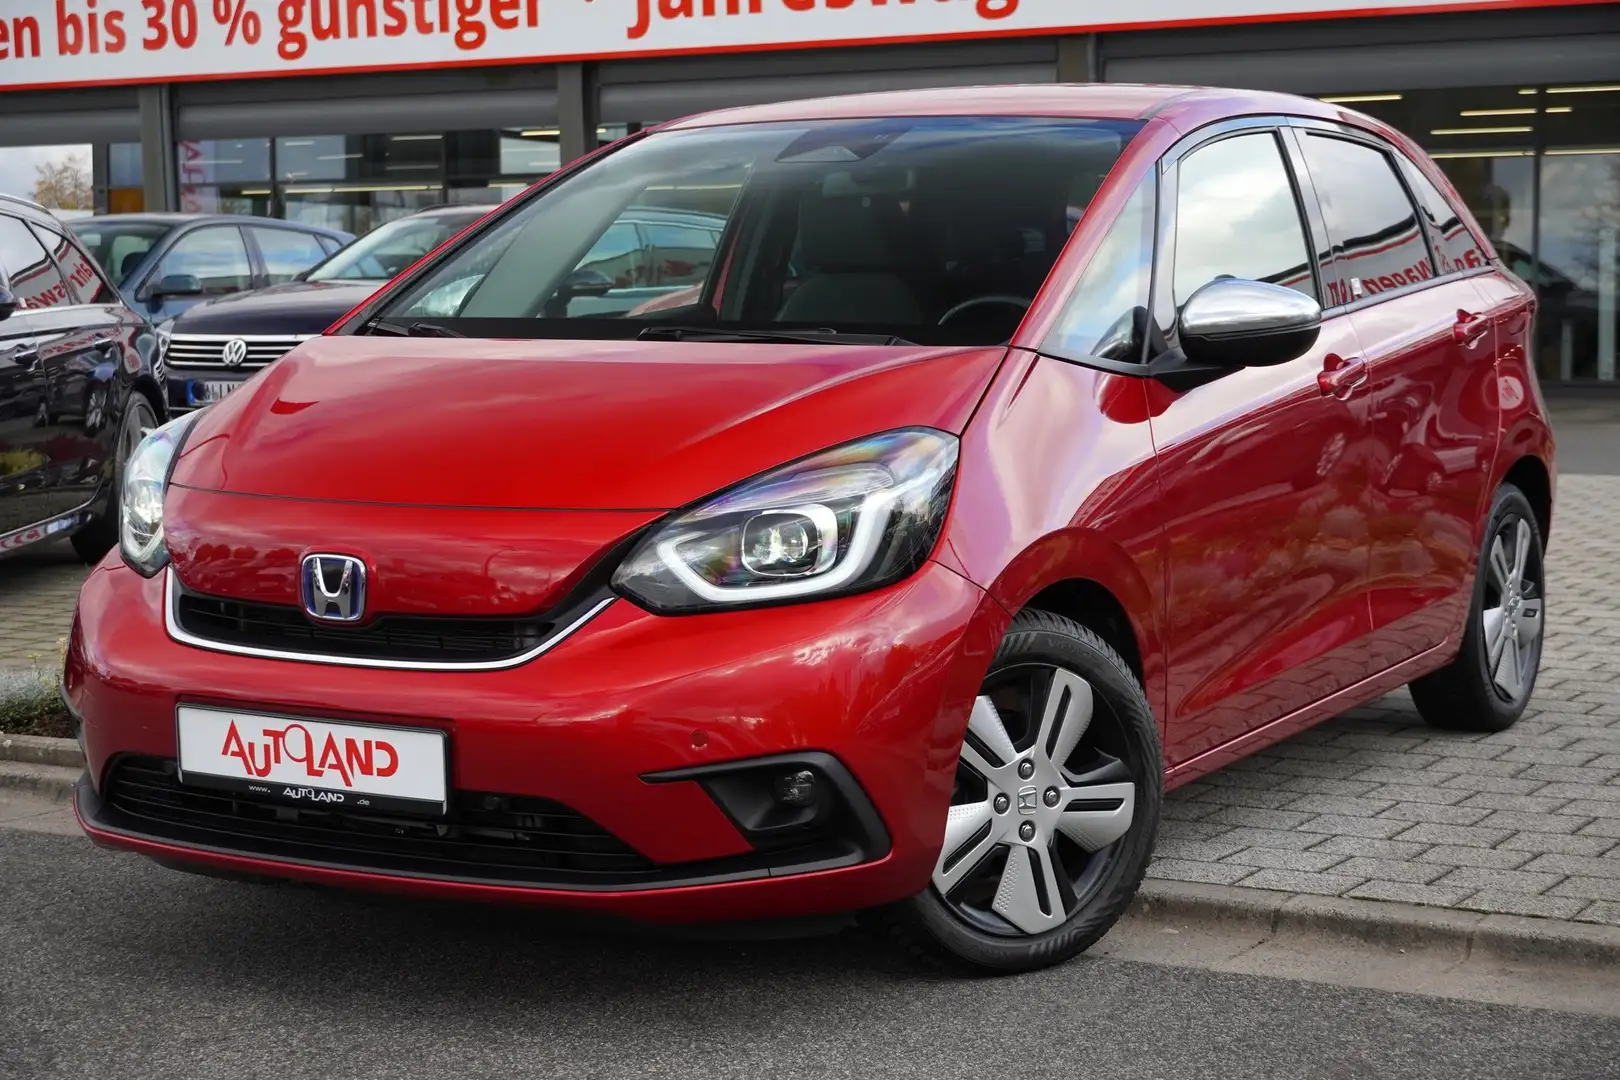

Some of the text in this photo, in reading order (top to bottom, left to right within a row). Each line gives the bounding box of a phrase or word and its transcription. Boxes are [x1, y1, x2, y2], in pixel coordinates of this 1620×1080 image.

[55, 0, 127, 56] bis
[142, 0, 198, 51] 30
[212, 0, 262, 47] %
[248, 784, 271, 793] www.
